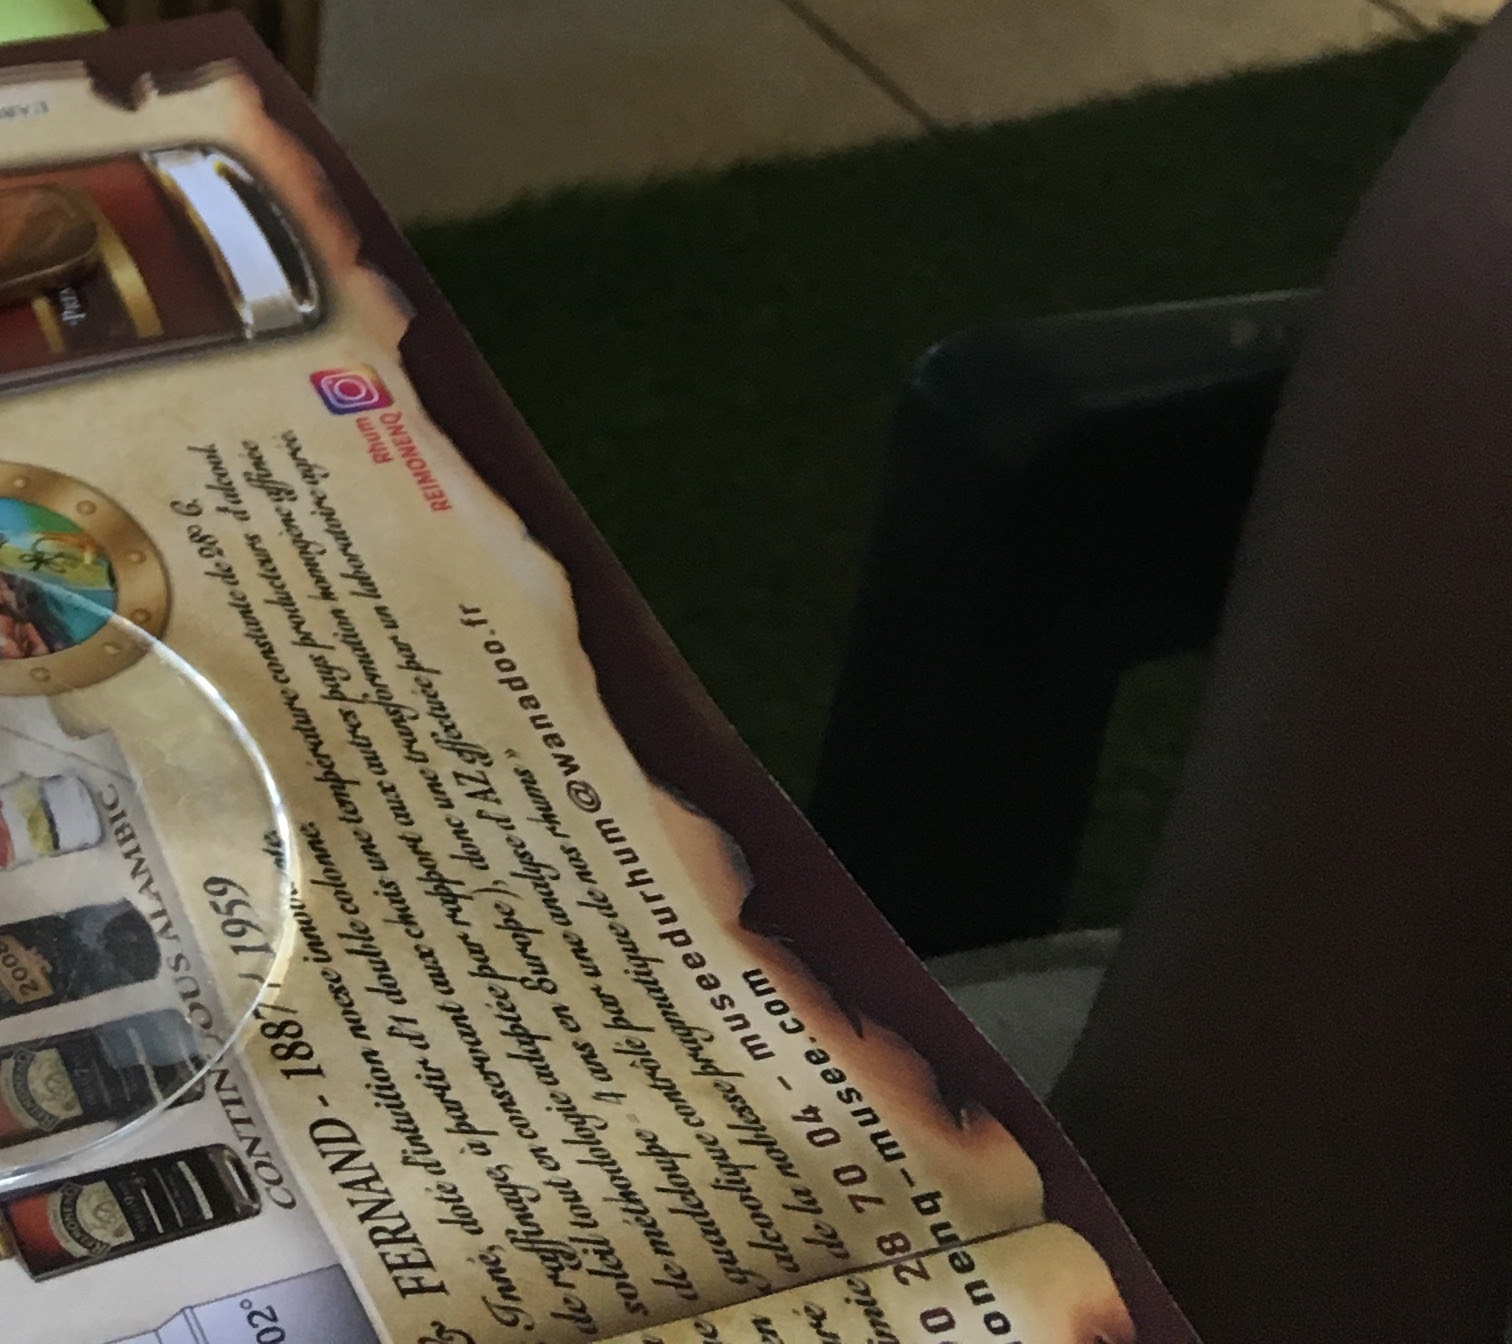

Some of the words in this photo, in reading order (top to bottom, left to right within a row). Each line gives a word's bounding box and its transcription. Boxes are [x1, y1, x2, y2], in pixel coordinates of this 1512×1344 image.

[309, 489, 382, 600] laboratoire
[203, 561, 240, 587] de
[243, 532, 336, 651] producteurs
[227, 590, 292, 685] constante
[373, 604, 400, 631] un
[308, 654, 370, 705] pays
[329, 607, 430, 765] transformation
[388, 634, 442, 682] par
[279, 687, 364, 825] température
[337, 707, 388, 777] autres
[376, 779, 416, 827] aux
[418, 767, 456, 810] une
[512, 765, 570, 840] rhums
[352, 828, 390, 873] une
[444, 817, 491, 872] donc
[559, 843, 598, 885] nos
[396, 834, 475, 927] rapport
[504, 835, 573, 928] analyse
[575, 888, 619, 920] de
[201, 875, 274, 958] 1959
[372, 880, 425, 940] chais
[336, 920, 408, 1006] double
[412, 943, 456, 996] aux
[455, 931, 519, 991] par
[561, 930, 603, 979] une
[550, 1003, 582, 1034] en
[589, 983, 655, 1033] par
[607, 921, 743, 1078] pragmatique
[484, 984, 561, 1087] adaptée
[571, 1040, 614, 1083] ans
[413, 1058, 498, 1137] partir
[435, 1003, 540, 1141] conservant
[712, 1080, 801, 1179] noblesse
[790, 1104, 842, 1149] 04
[528, 1145, 562, 1172] en
[544, 1091, 676, 1258] méthodologie
[308, 1117, 451, 1301] FERNAND
[424, 1183, 485, 1237] doté
[542, 1178, 600, 1230] tout
[634, 1128, 773, 1297] guadeloupe
[694, 1126, 802, 1275] alcoolique
[780, 1186, 824, 1216] la
[831, 1163, 887, 1213] 70
[801, 1222, 851, 1260] de
[567, 1236, 652, 1317] soleil
[650, 1263, 702, 1303] de
